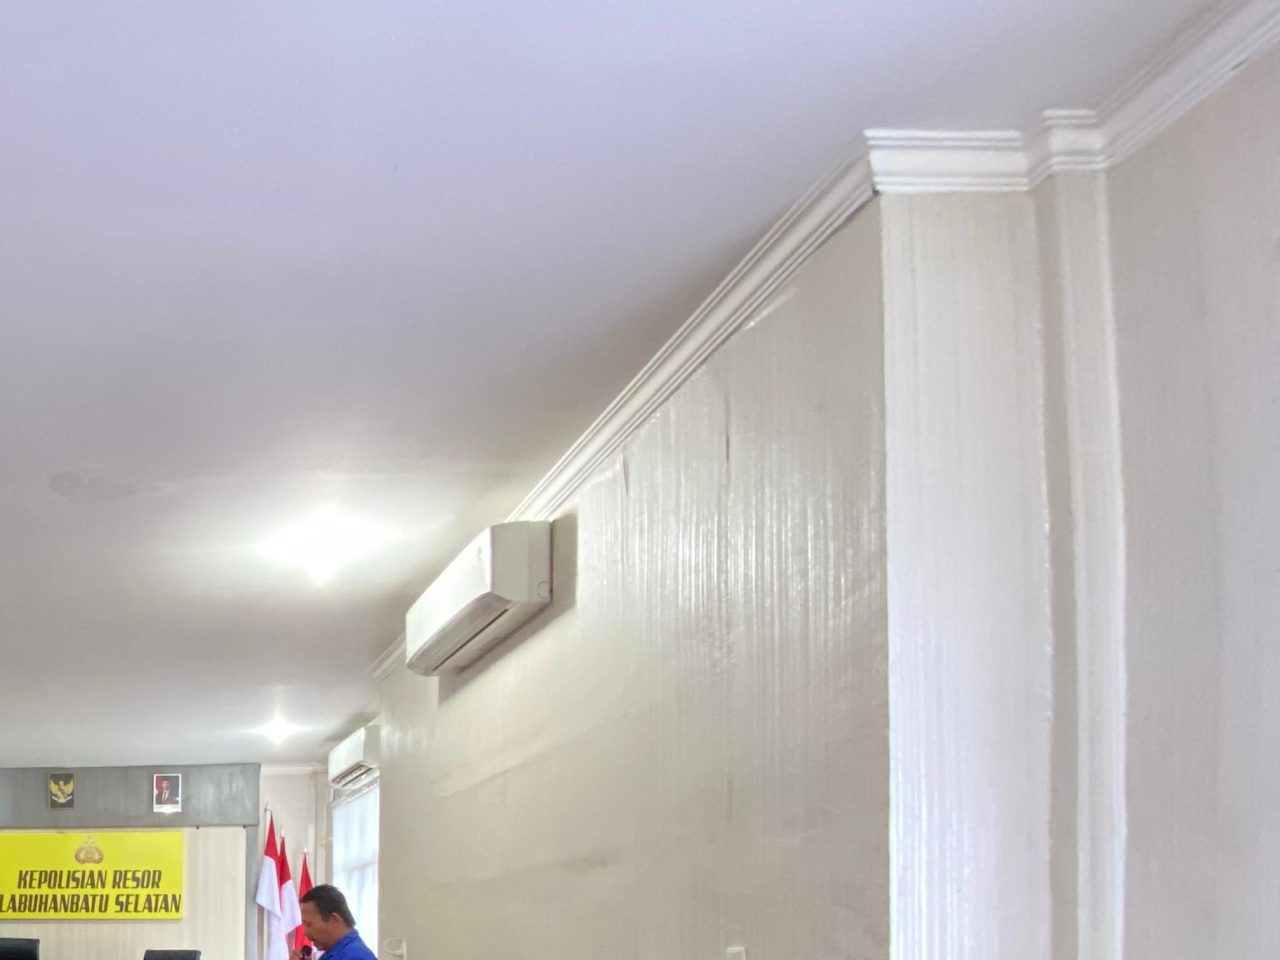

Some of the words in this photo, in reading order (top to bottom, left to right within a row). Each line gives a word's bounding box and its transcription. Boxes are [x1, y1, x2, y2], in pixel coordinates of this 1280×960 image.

[17, 870, 108, 889] KEPOLISIAN
[112, 870, 162, 889] RESOR
[114, 894, 181, 913] SELATAN
